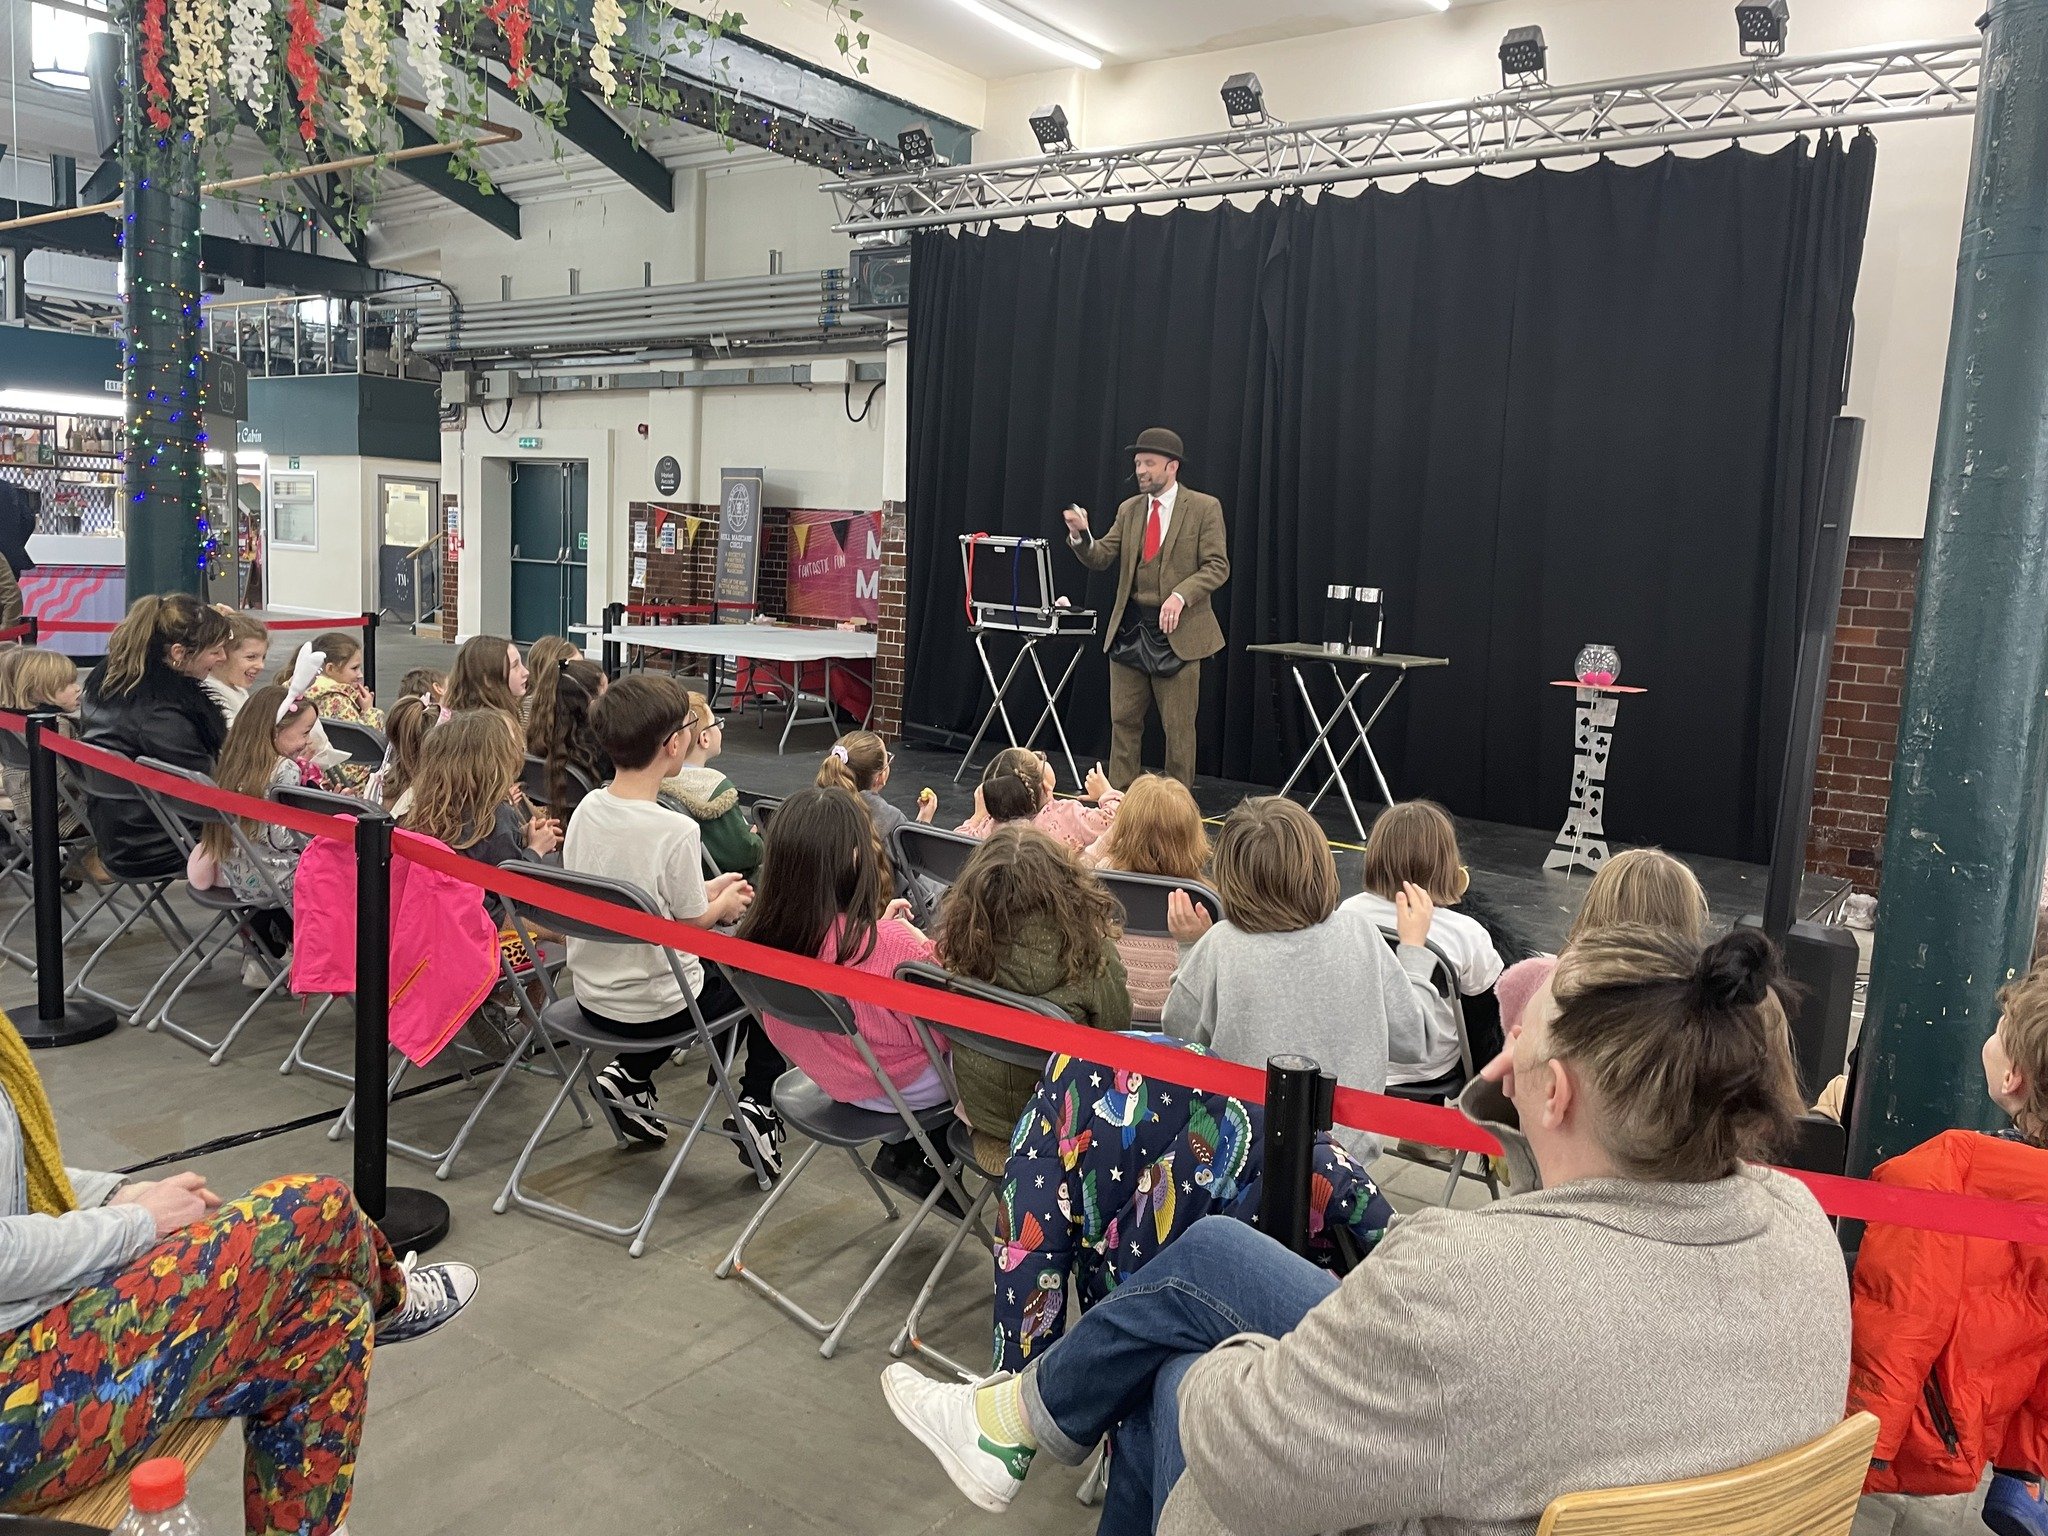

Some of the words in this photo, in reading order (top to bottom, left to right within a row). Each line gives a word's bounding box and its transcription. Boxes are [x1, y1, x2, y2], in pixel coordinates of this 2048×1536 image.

[242, 427, 262, 443] Cabin
[729, 541, 744, 549] CIRCLE
[798, 557, 829, 578] FANTASTIC
[834, 554, 846, 569] FUN
